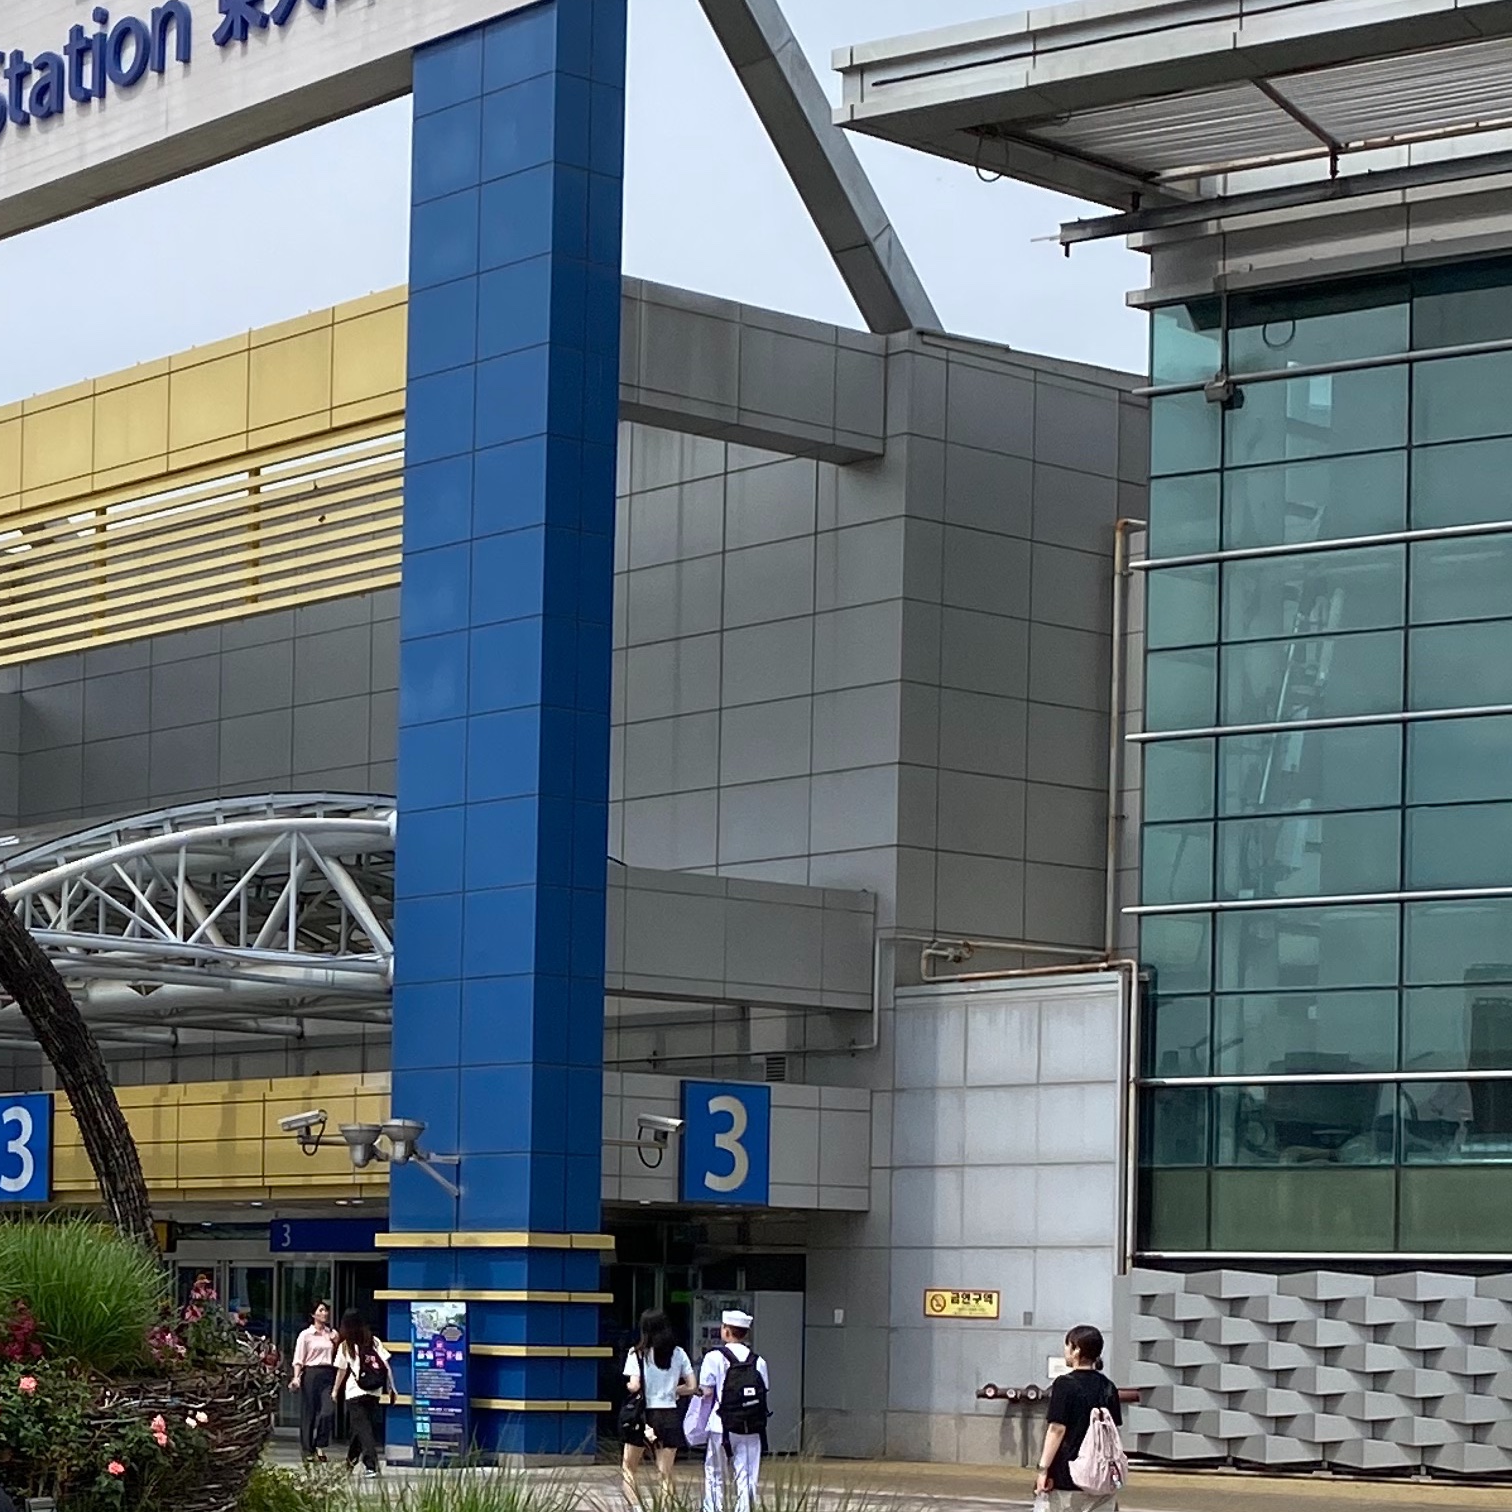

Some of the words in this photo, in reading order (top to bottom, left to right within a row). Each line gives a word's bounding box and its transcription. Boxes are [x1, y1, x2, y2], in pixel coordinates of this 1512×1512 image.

[0, 1105, 35, 1193] 3
[704, 1095, 750, 1192] 3
[281, 1223, 291, 1247] 3
[951, 1292, 993, 1305] 금연구역
